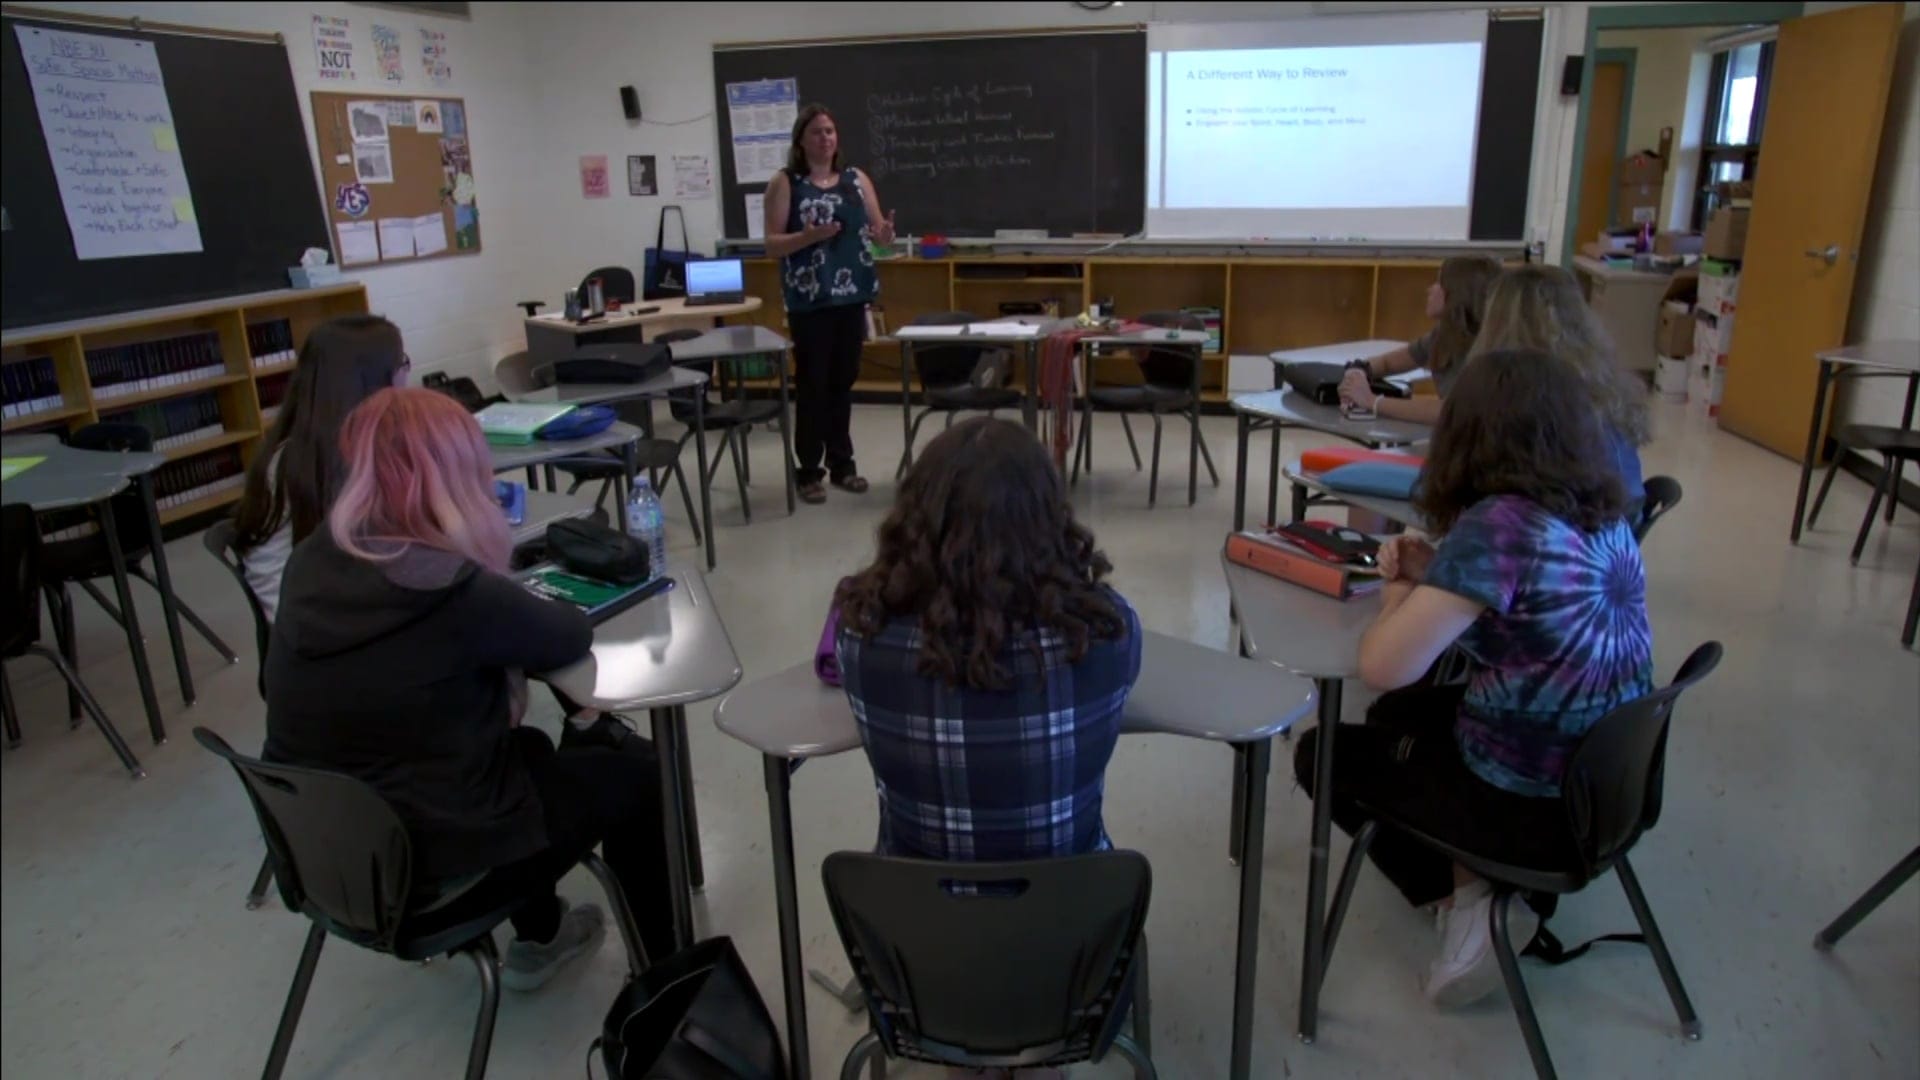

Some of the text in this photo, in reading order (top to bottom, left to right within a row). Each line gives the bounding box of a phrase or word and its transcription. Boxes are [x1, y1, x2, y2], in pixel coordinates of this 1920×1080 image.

[321, 51, 354, 69] NOT
[1187, 70, 1195, 80] A
[1198, 69, 1253, 80] Different
[1256, 69, 1283, 82] Way
[1302, 67, 1348, 78] Review
[56, 83, 106, 103] Respect
